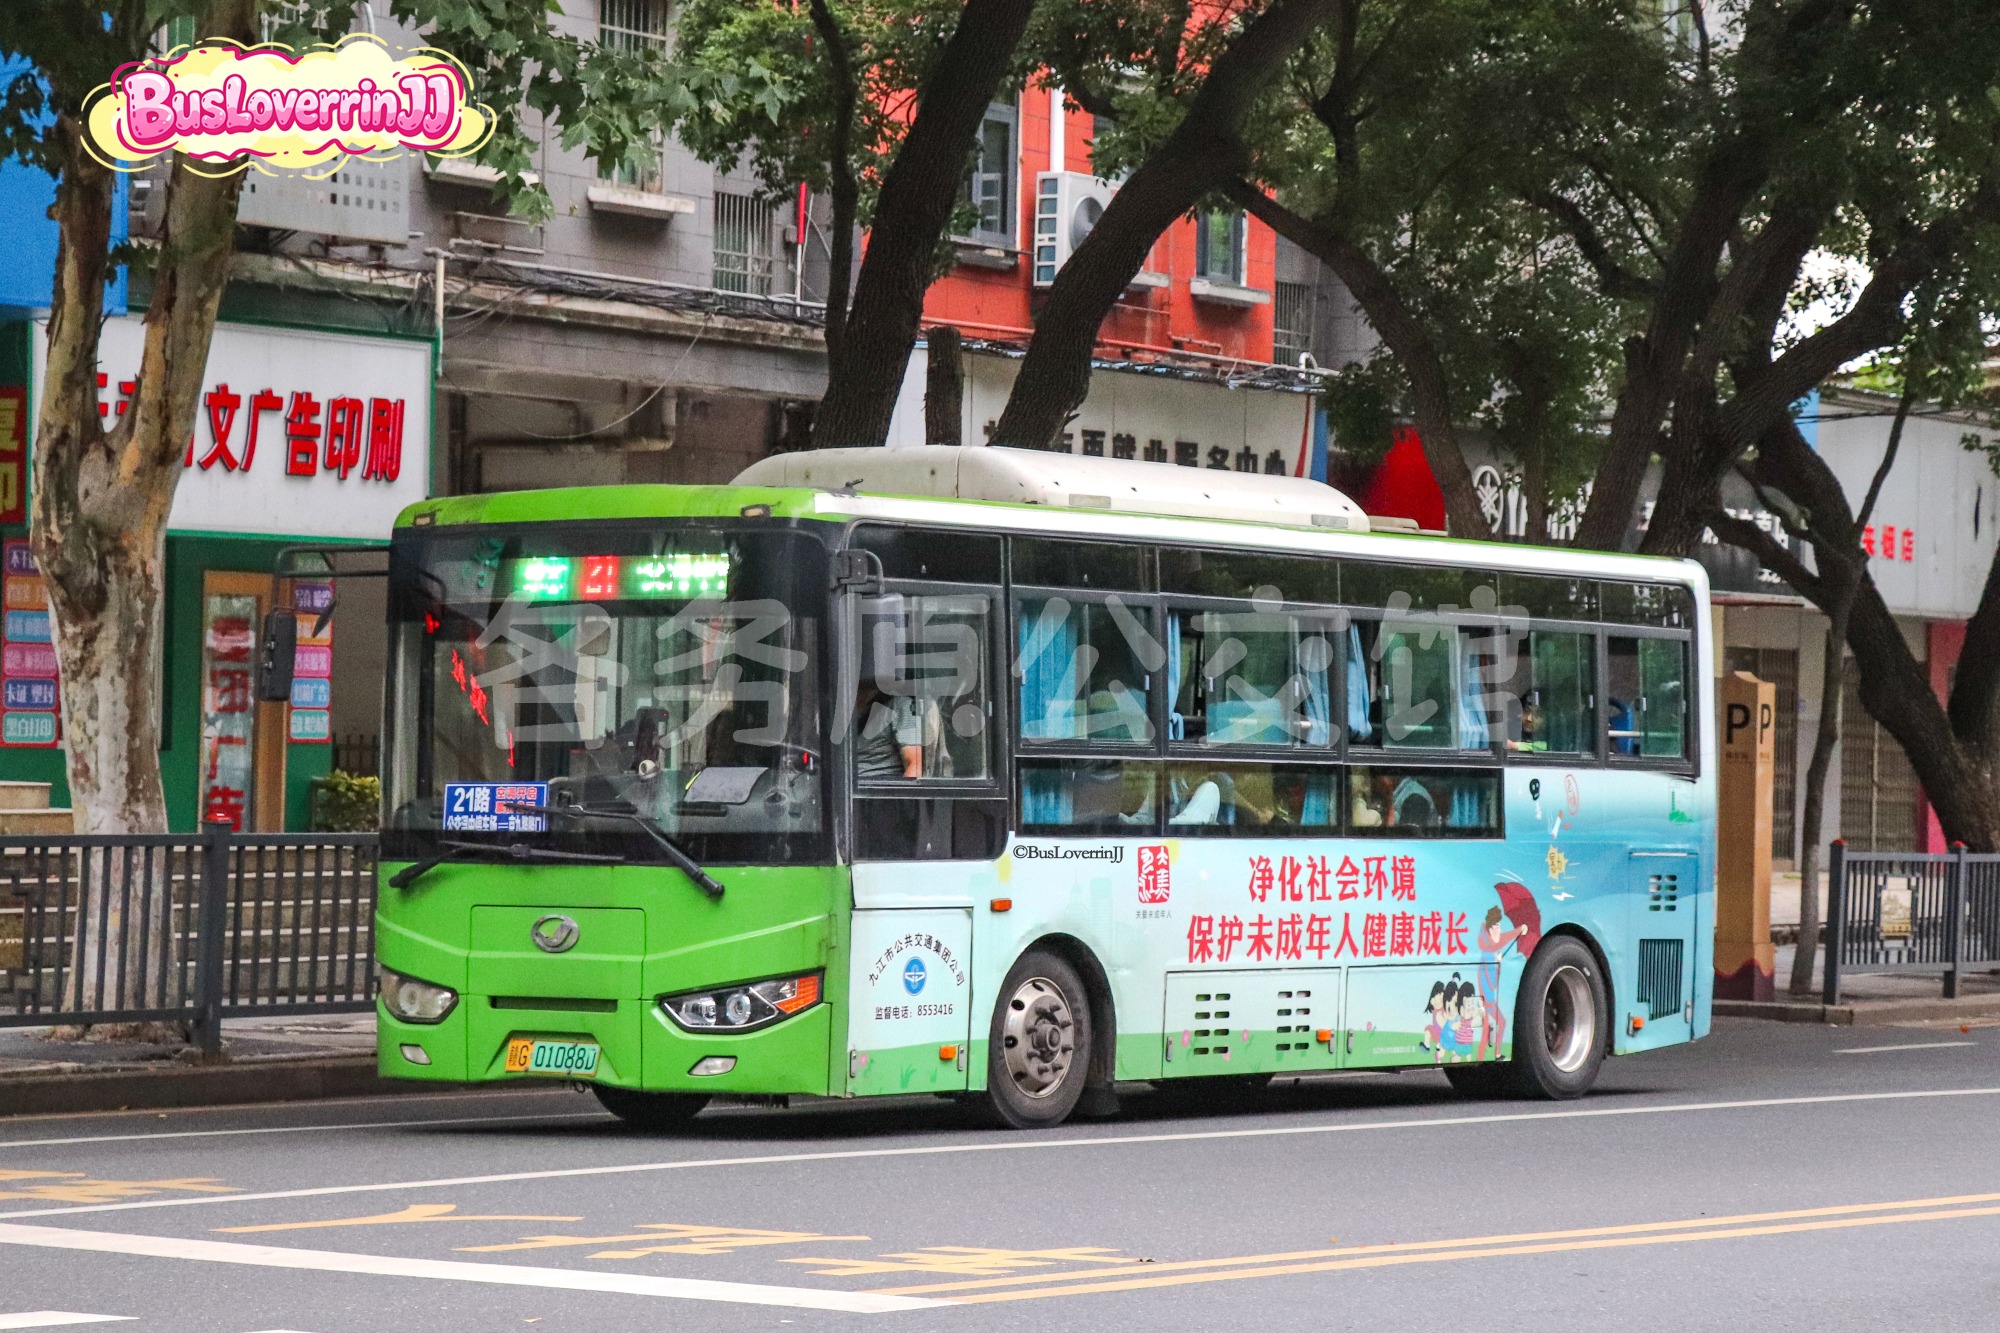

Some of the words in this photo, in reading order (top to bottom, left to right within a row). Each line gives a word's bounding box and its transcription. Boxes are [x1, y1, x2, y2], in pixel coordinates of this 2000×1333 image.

[97, 373, 405, 482] 文广告印刷
[1726, 703, 1750, 744] P
[1760, 704, 1771, 744] P
[453, 787, 490, 813] 21路
[1248, 855, 1417, 902] 净化社会环境
[868, 933, 965, 987] 九江市公共交通集团公司
[1186, 910, 1469, 964] 保护未成年人健康成长
